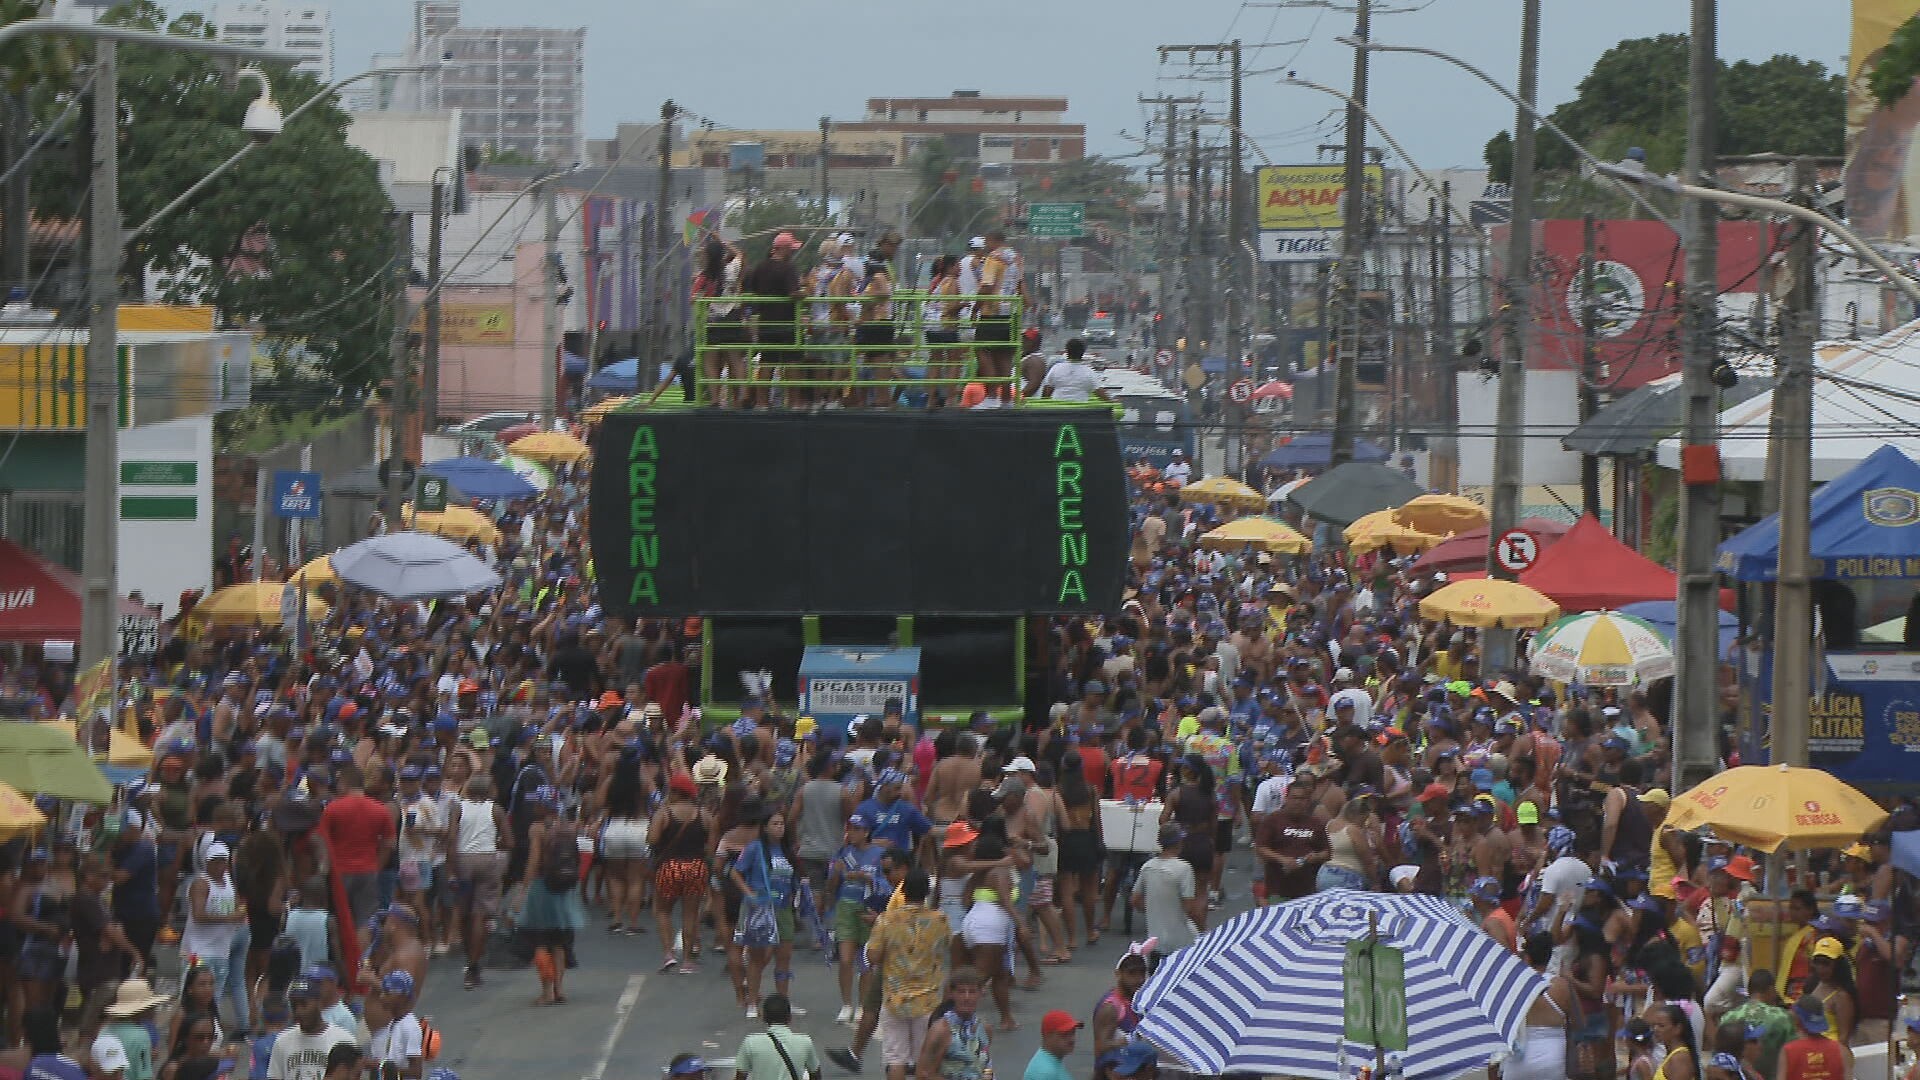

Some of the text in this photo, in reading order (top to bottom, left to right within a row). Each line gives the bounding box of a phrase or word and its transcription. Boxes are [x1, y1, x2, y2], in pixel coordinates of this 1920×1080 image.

[1275, 238, 1332, 254] TIGRE
[628, 424, 660, 605] ARENA
[1055, 423, 1088, 604] ARENA
[1835, 556, 1903, 578] POLÍCIA
[814, 681, 904, 695] D'CASTRO
